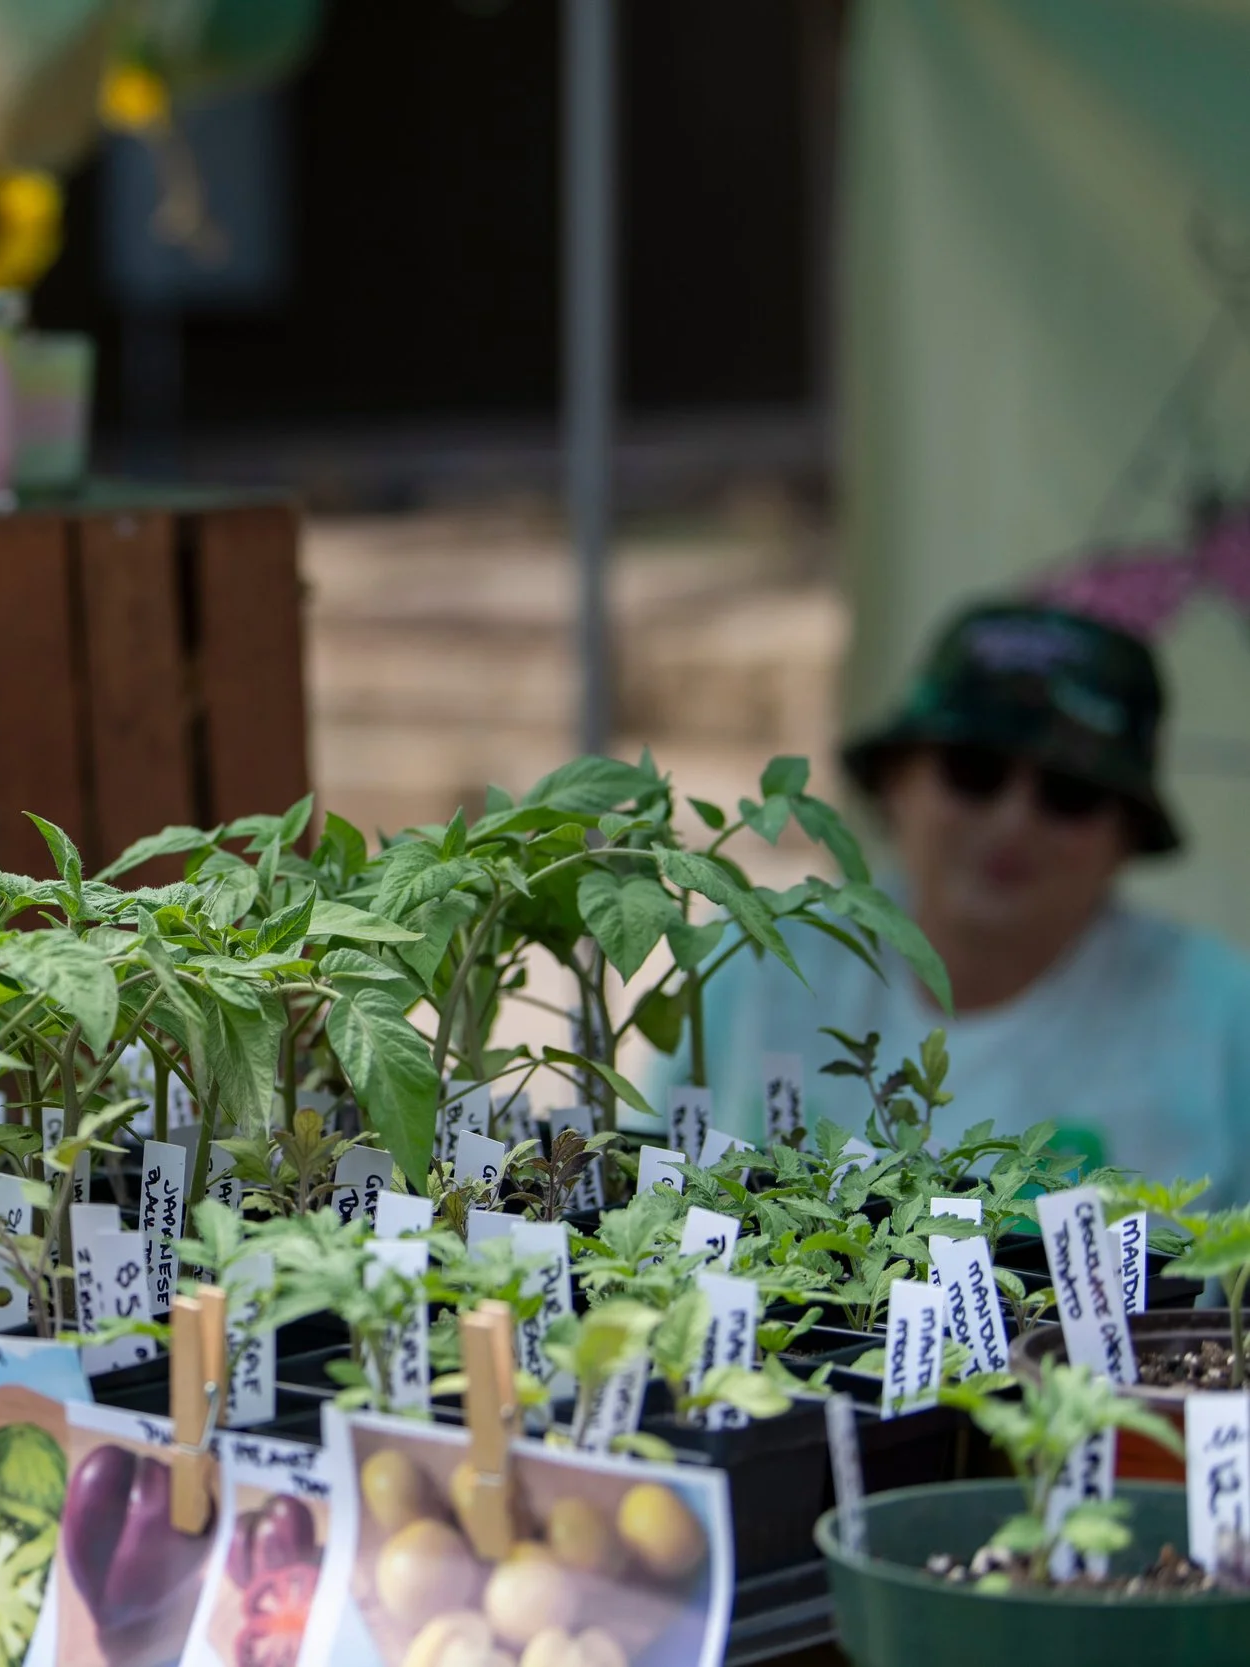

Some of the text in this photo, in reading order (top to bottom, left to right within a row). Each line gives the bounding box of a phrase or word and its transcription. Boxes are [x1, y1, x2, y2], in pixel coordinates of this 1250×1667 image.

[143, 1165, 162, 1232] BLACK
[156, 1178, 181, 1307] JAPANESE
[363, 1173, 384, 1232] GRE
[1053, 1217, 1082, 1321] TOMATO
[1075, 1202, 1113, 1320] CHOCOLATE
[1122, 1219, 1141, 1314] MANDU
